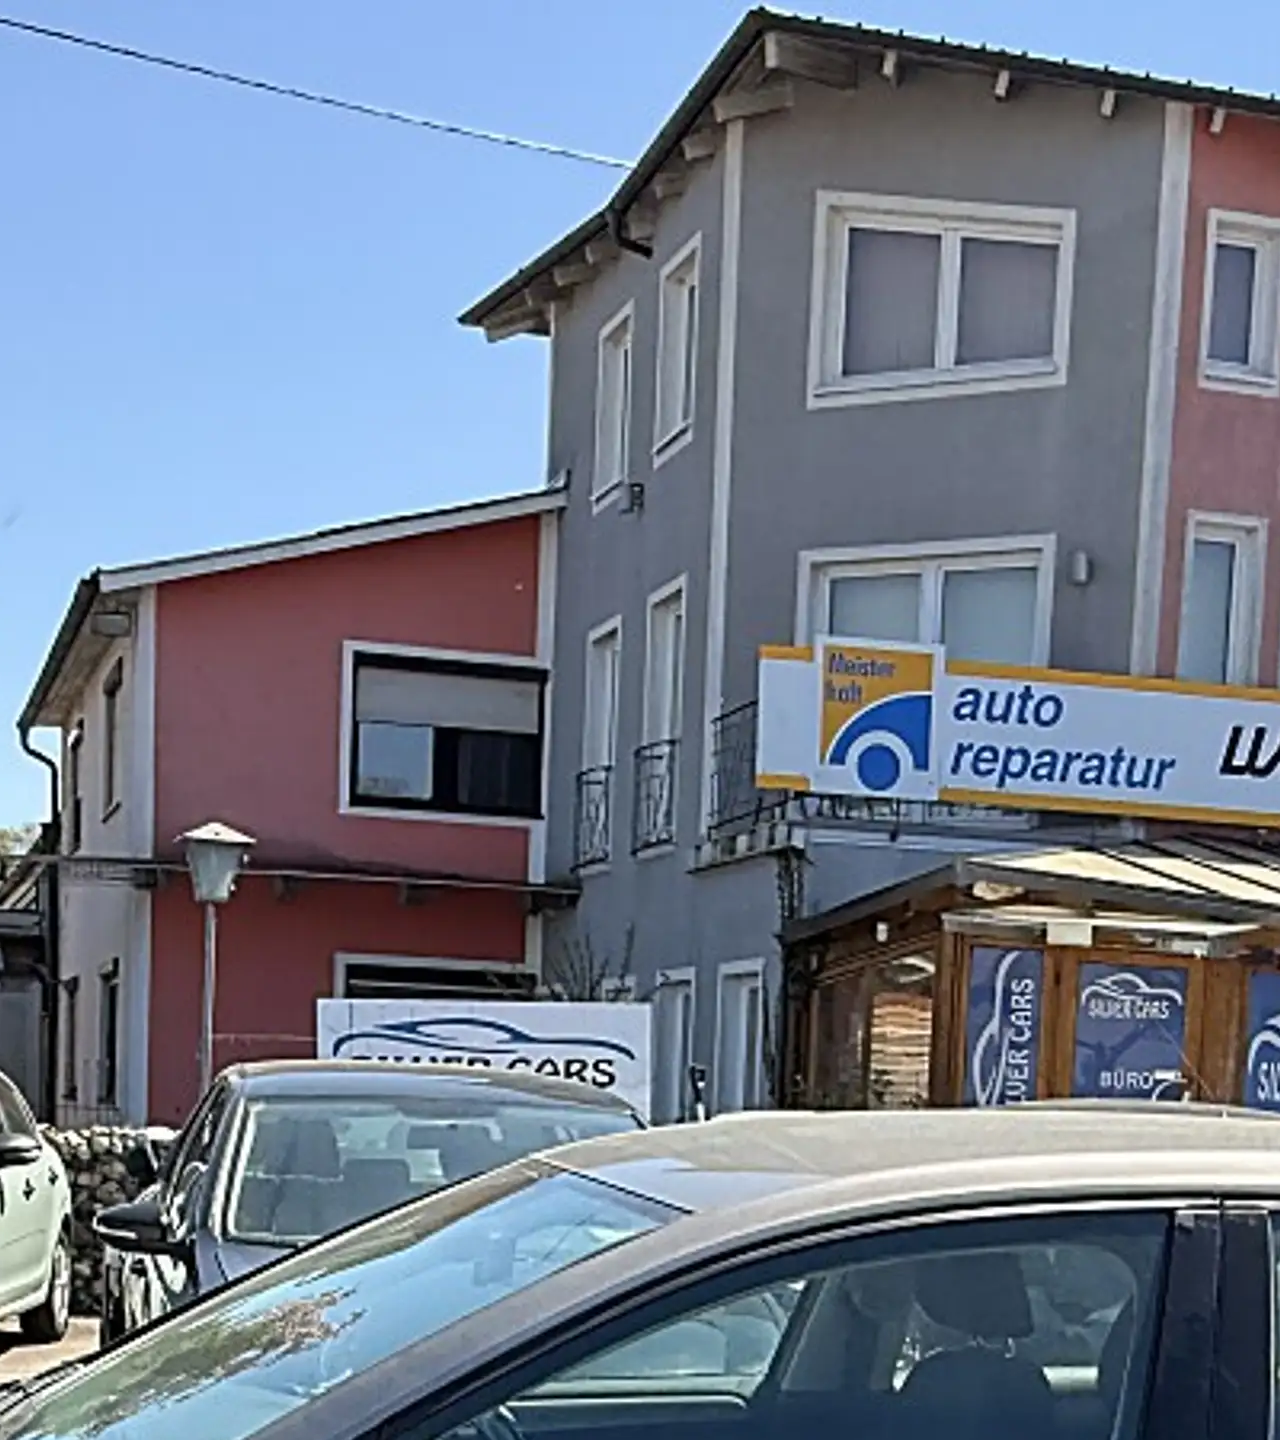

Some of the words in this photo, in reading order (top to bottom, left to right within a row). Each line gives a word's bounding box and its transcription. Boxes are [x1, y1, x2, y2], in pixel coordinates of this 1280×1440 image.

[953, 685, 1063, 728] auto
[950, 740, 1177, 792] reparatur
[1010, 977, 1036, 1042] CARS
[1004, 1049, 1029, 1105] LVER
[1099, 1066, 1154, 1090] BÜRO
